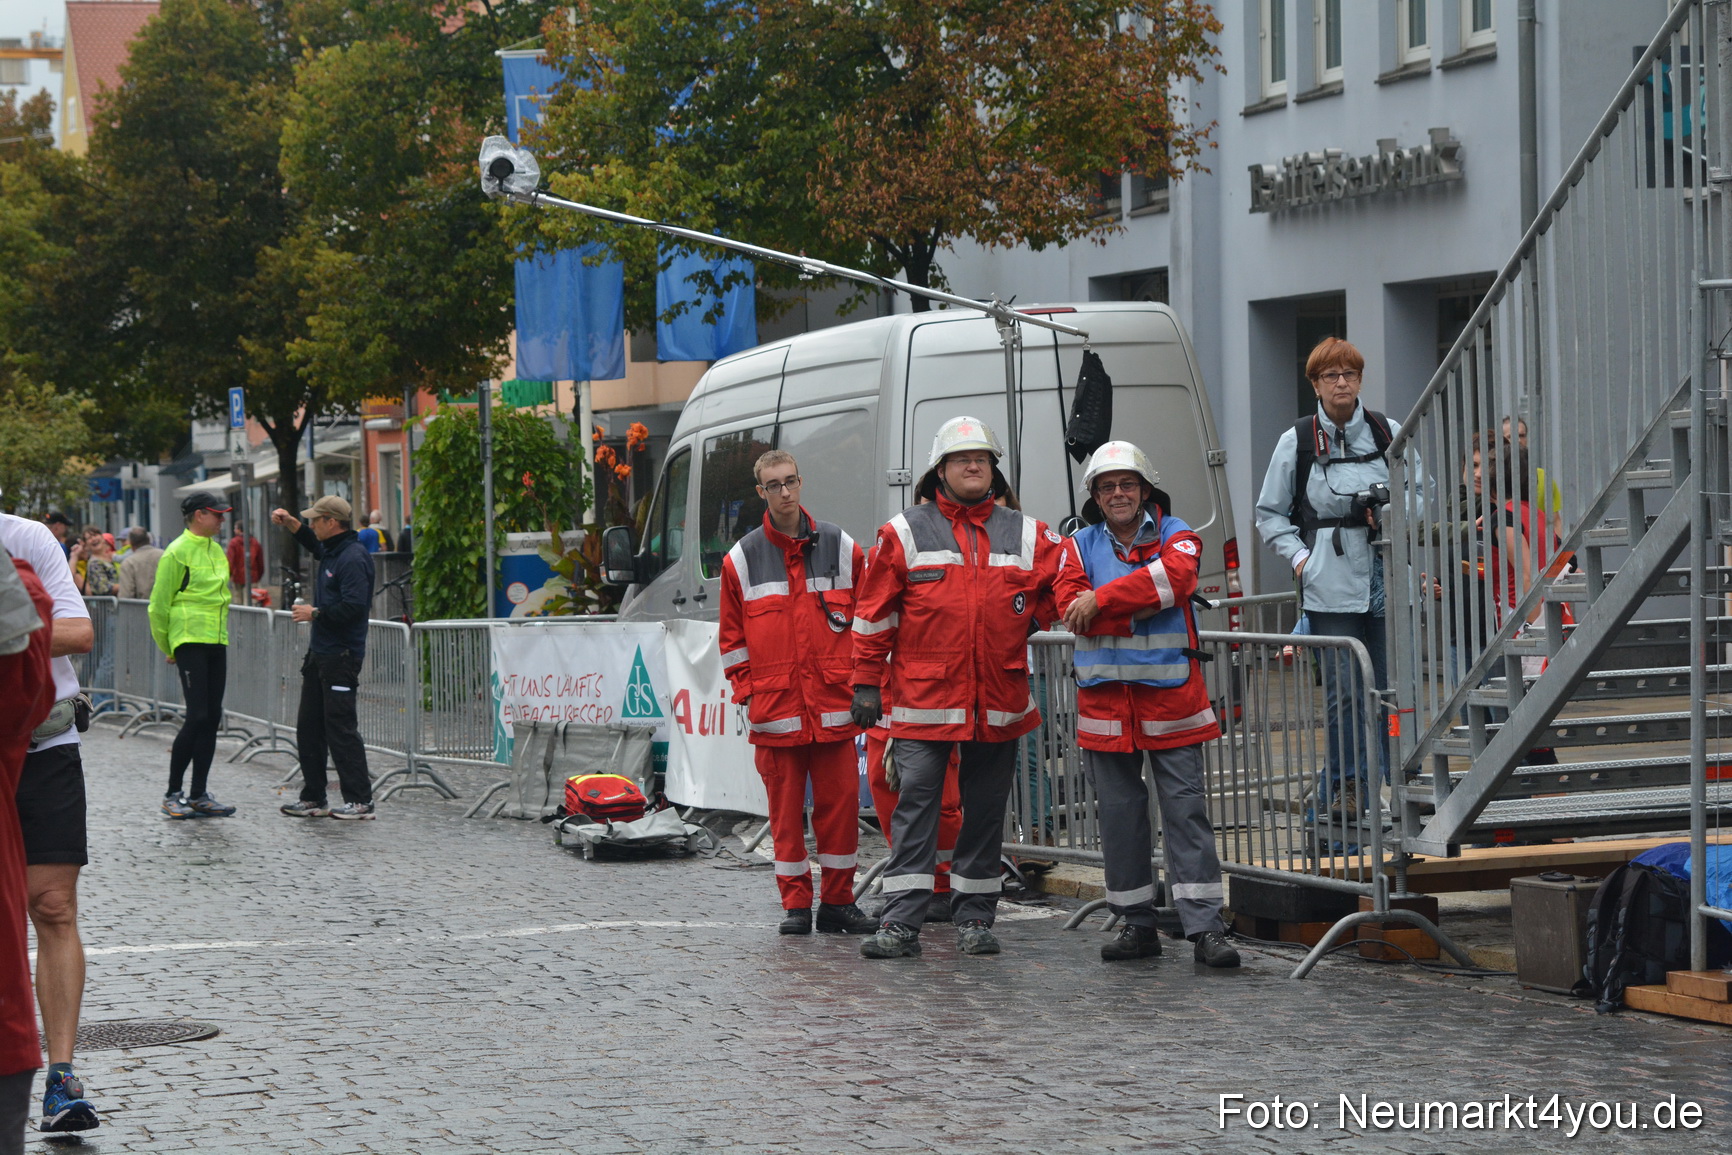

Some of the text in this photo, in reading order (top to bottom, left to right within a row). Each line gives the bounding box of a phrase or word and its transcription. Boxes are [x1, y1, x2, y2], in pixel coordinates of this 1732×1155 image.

[1248, 128, 1464, 214] Raiffeisenbank
[1203, 586, 1221, 594] CDI
[520, 674, 553, 698] UNS
